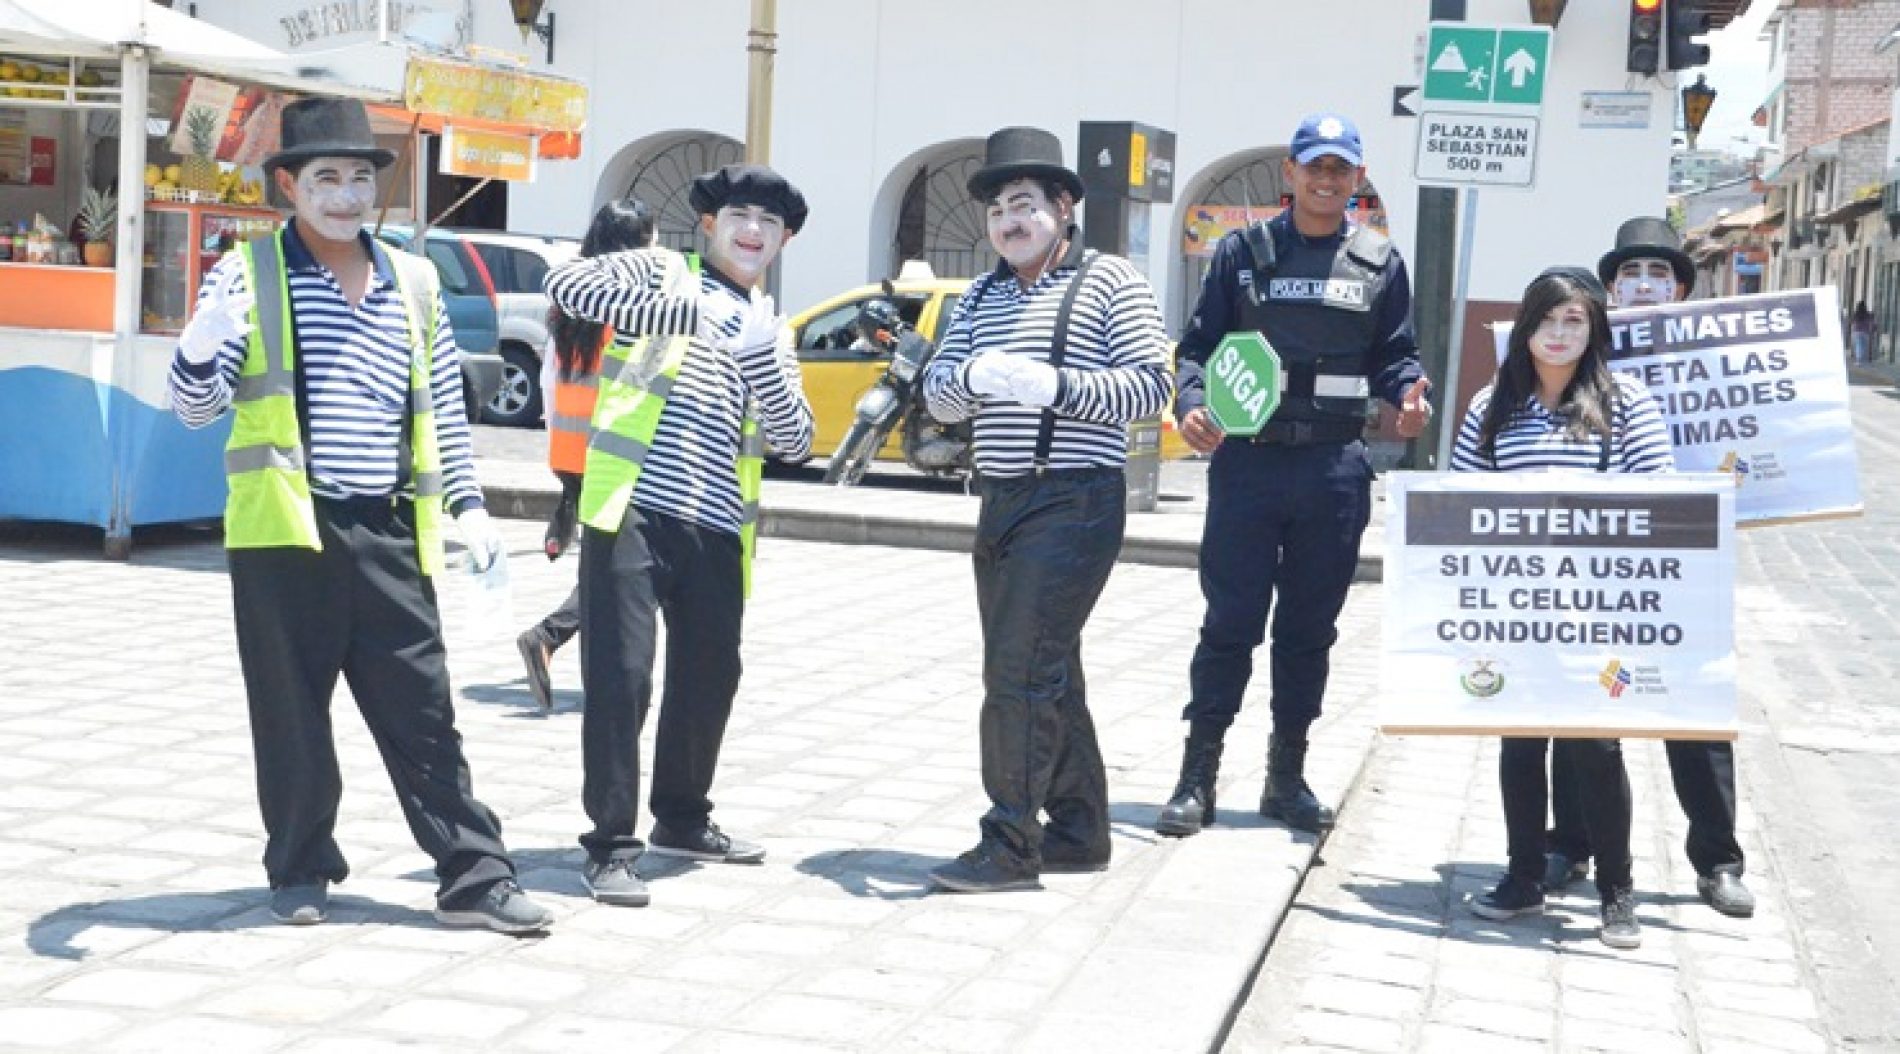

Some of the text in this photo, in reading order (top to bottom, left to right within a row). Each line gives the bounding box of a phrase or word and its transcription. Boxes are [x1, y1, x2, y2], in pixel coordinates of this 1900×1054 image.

[1429, 122, 1528, 140] PLAZA SAN
[1447, 156, 1502, 172] 500 m
[1665, 307, 1793, 343] MATES
[1720, 349, 1789, 378] LAS
[1215, 346, 1268, 422] SIGA
[1470, 508, 1651, 536] DETENTE
[1440, 554, 1682, 580] SI VAS A USAR
[1459, 587, 1662, 613] EL CELULAR
[1436, 619, 1684, 646] CONDUCIENDO
